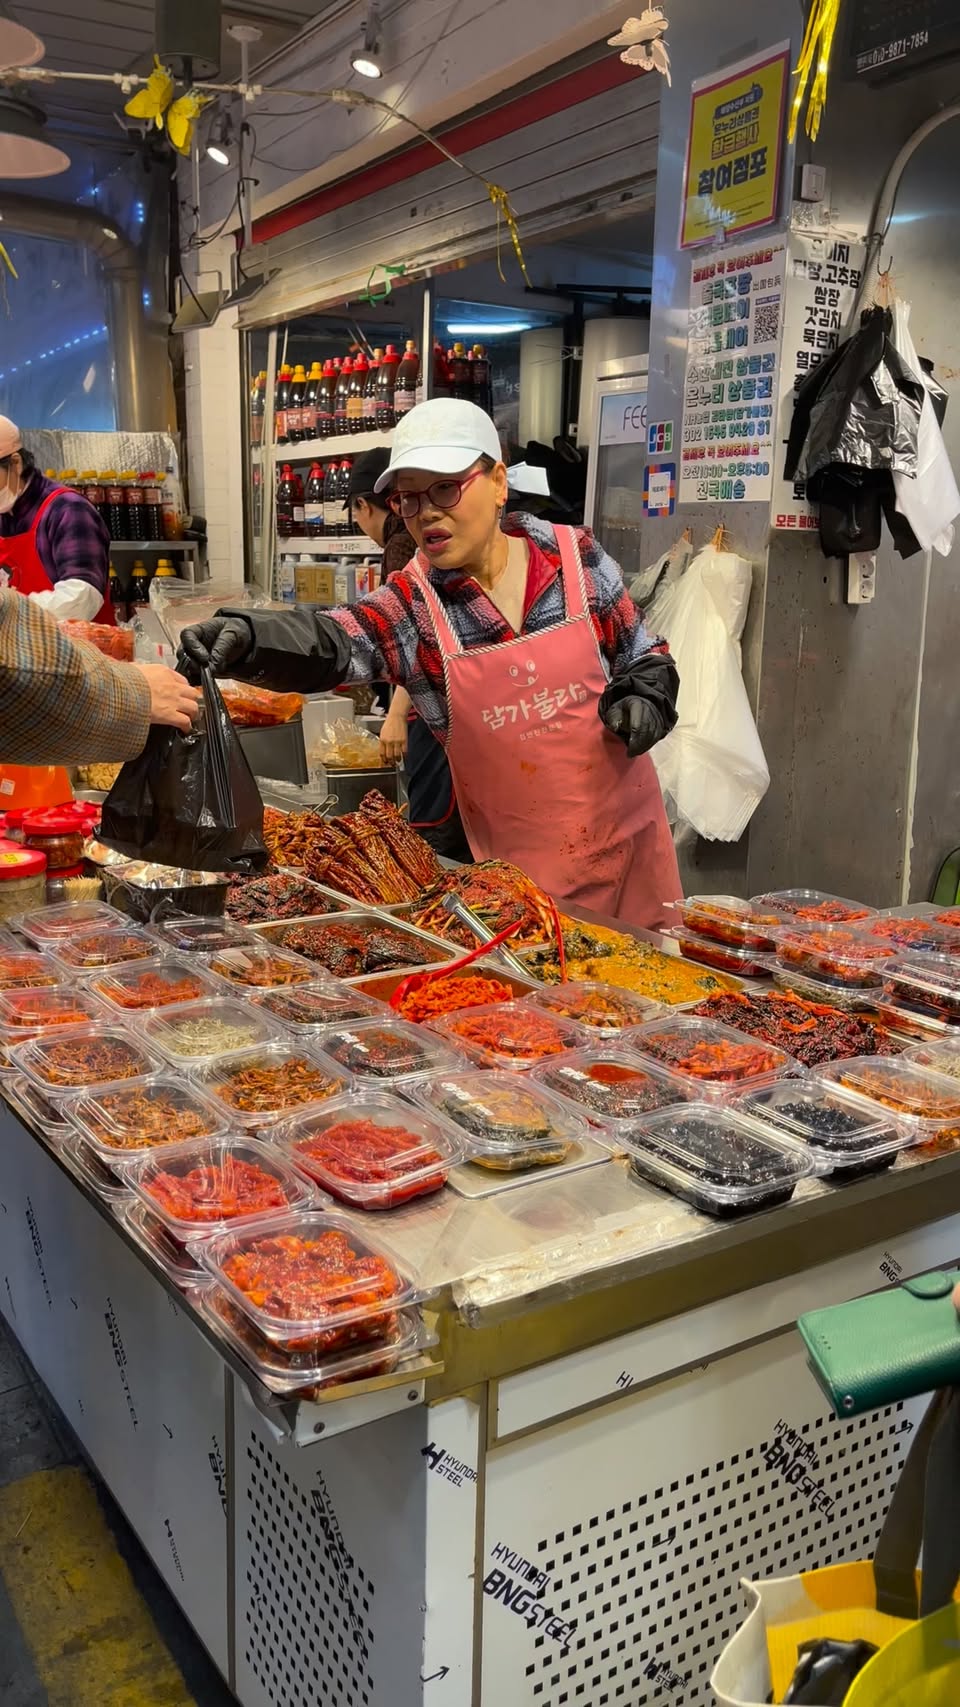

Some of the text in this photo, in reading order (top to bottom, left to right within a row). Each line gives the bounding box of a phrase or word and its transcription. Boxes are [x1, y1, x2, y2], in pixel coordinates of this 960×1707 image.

[698, 146, 768, 197] 참여점포
[814, 286, 840, 307] 쌈장
[805, 306, 842, 329] 갓김치
[803, 328, 840, 350] 묵은지
[736, 353, 775, 377] 상품권
[686, 383, 724, 408] 온누리
[728, 376, 772, 402] 상품권
[697, 479, 746, 500] 전국배송
[776, 514, 797, 528] 모든
[481, 683, 582, 730] 담가불라
[435, 1464, 463, 1487] STEEL
[443, 1454, 479, 1483] HYUNDA
[490, 1541, 551, 1589] HYUNDAI
